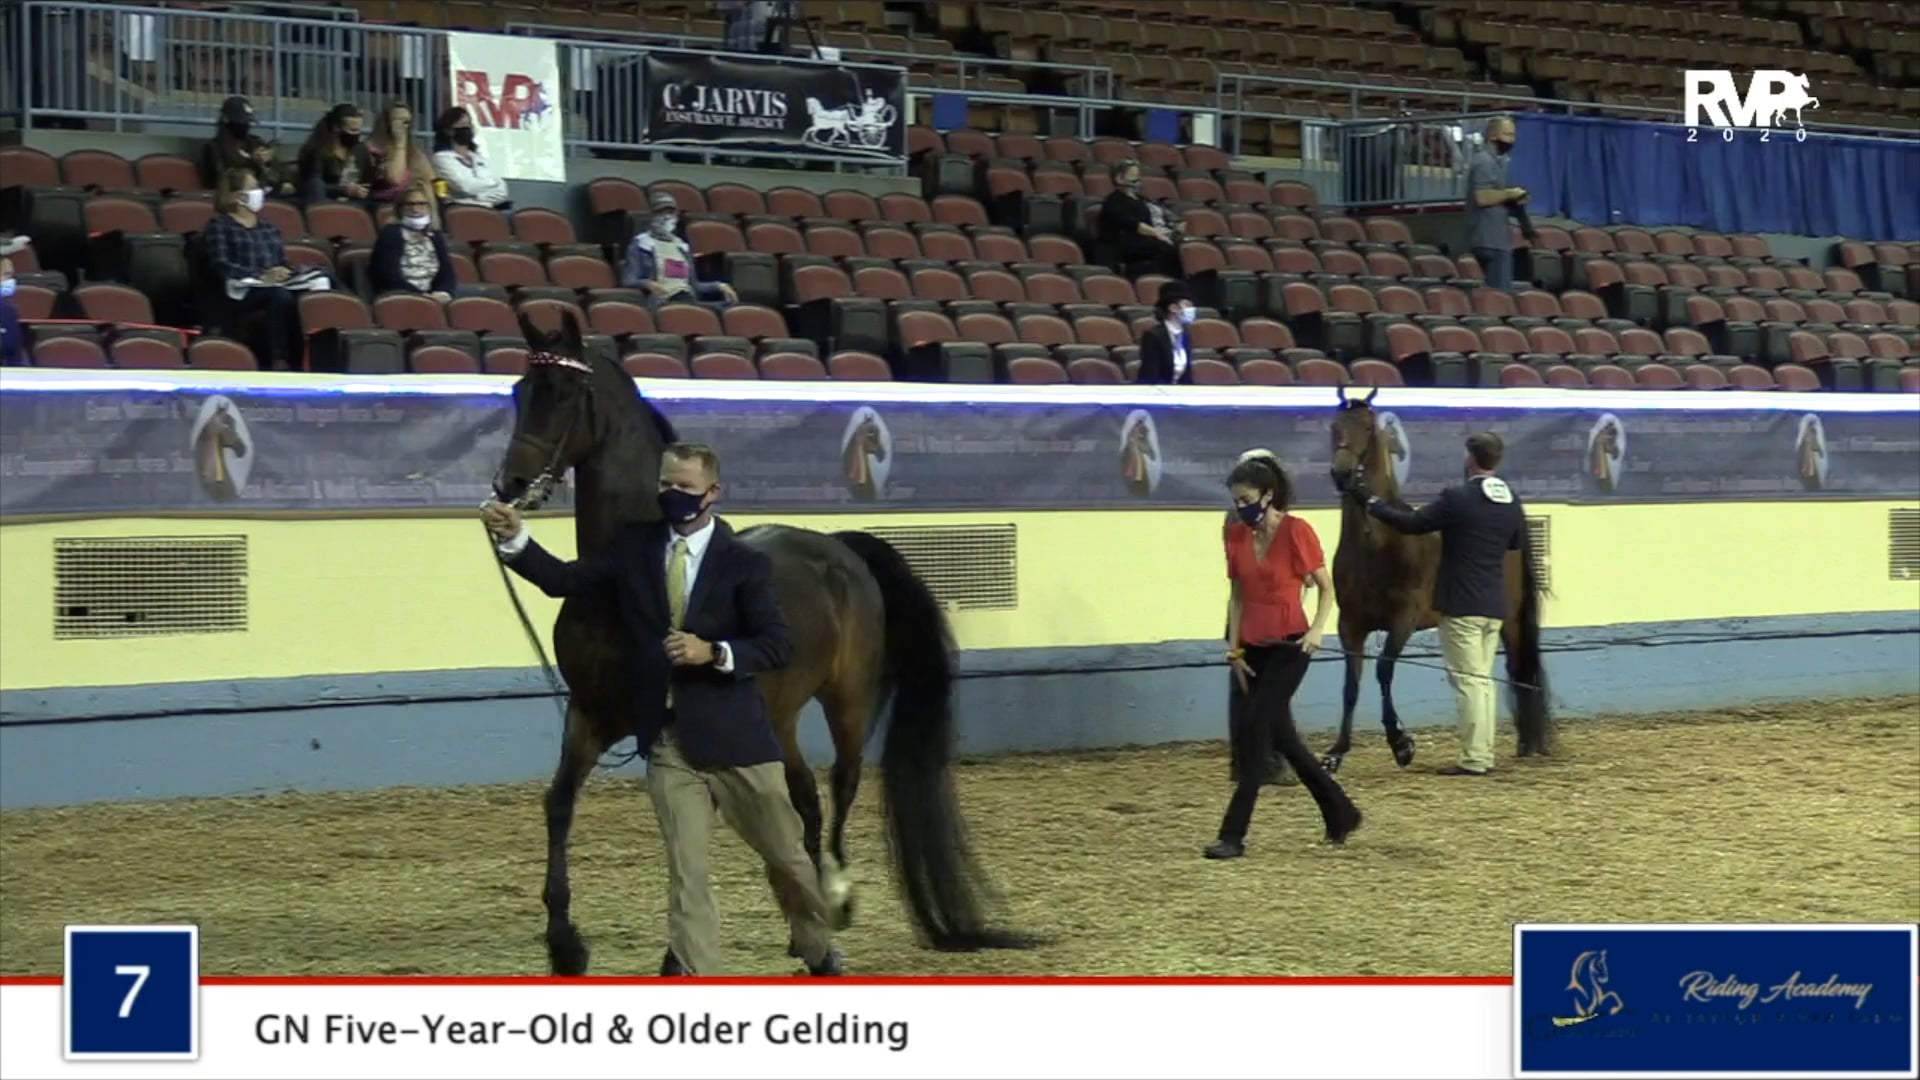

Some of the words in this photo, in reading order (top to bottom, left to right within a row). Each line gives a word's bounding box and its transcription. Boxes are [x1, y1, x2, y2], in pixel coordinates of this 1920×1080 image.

[456, 70, 535, 129] RVP
[662, 83, 686, 110] C.
[691, 85, 788, 117] JARVIS
